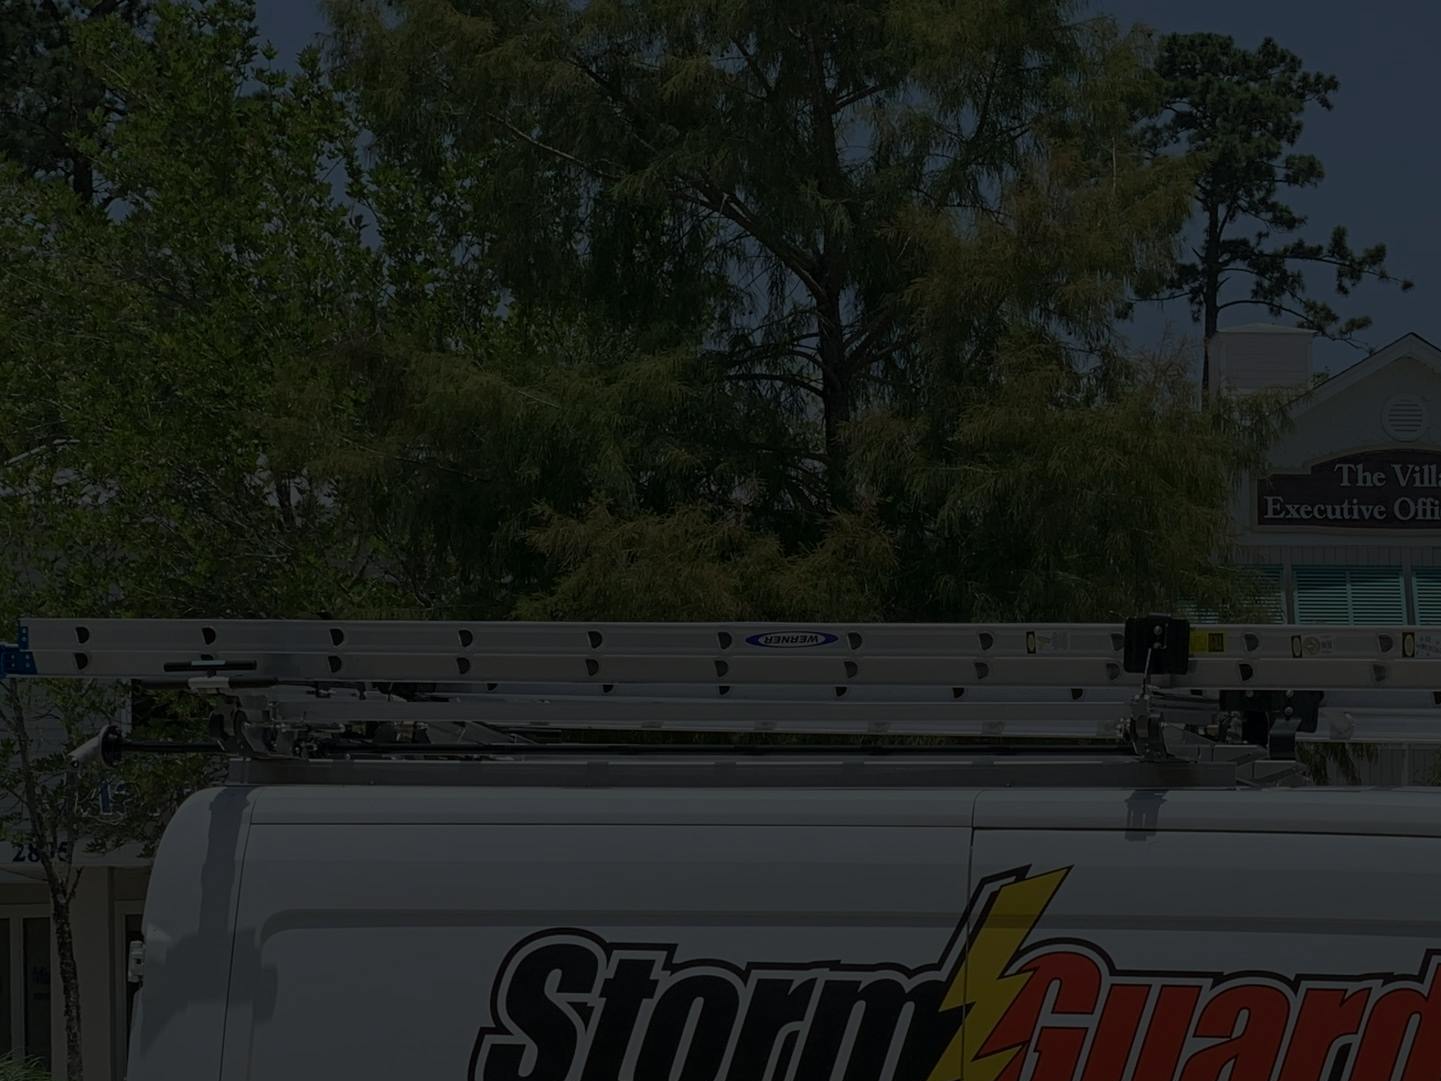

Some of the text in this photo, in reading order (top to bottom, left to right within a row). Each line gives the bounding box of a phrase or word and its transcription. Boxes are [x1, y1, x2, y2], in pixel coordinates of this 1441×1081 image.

[1334, 463, 1387, 489] The
[1263, 495, 1387, 521] Executive
[763, 635, 819, 645] WERNER
